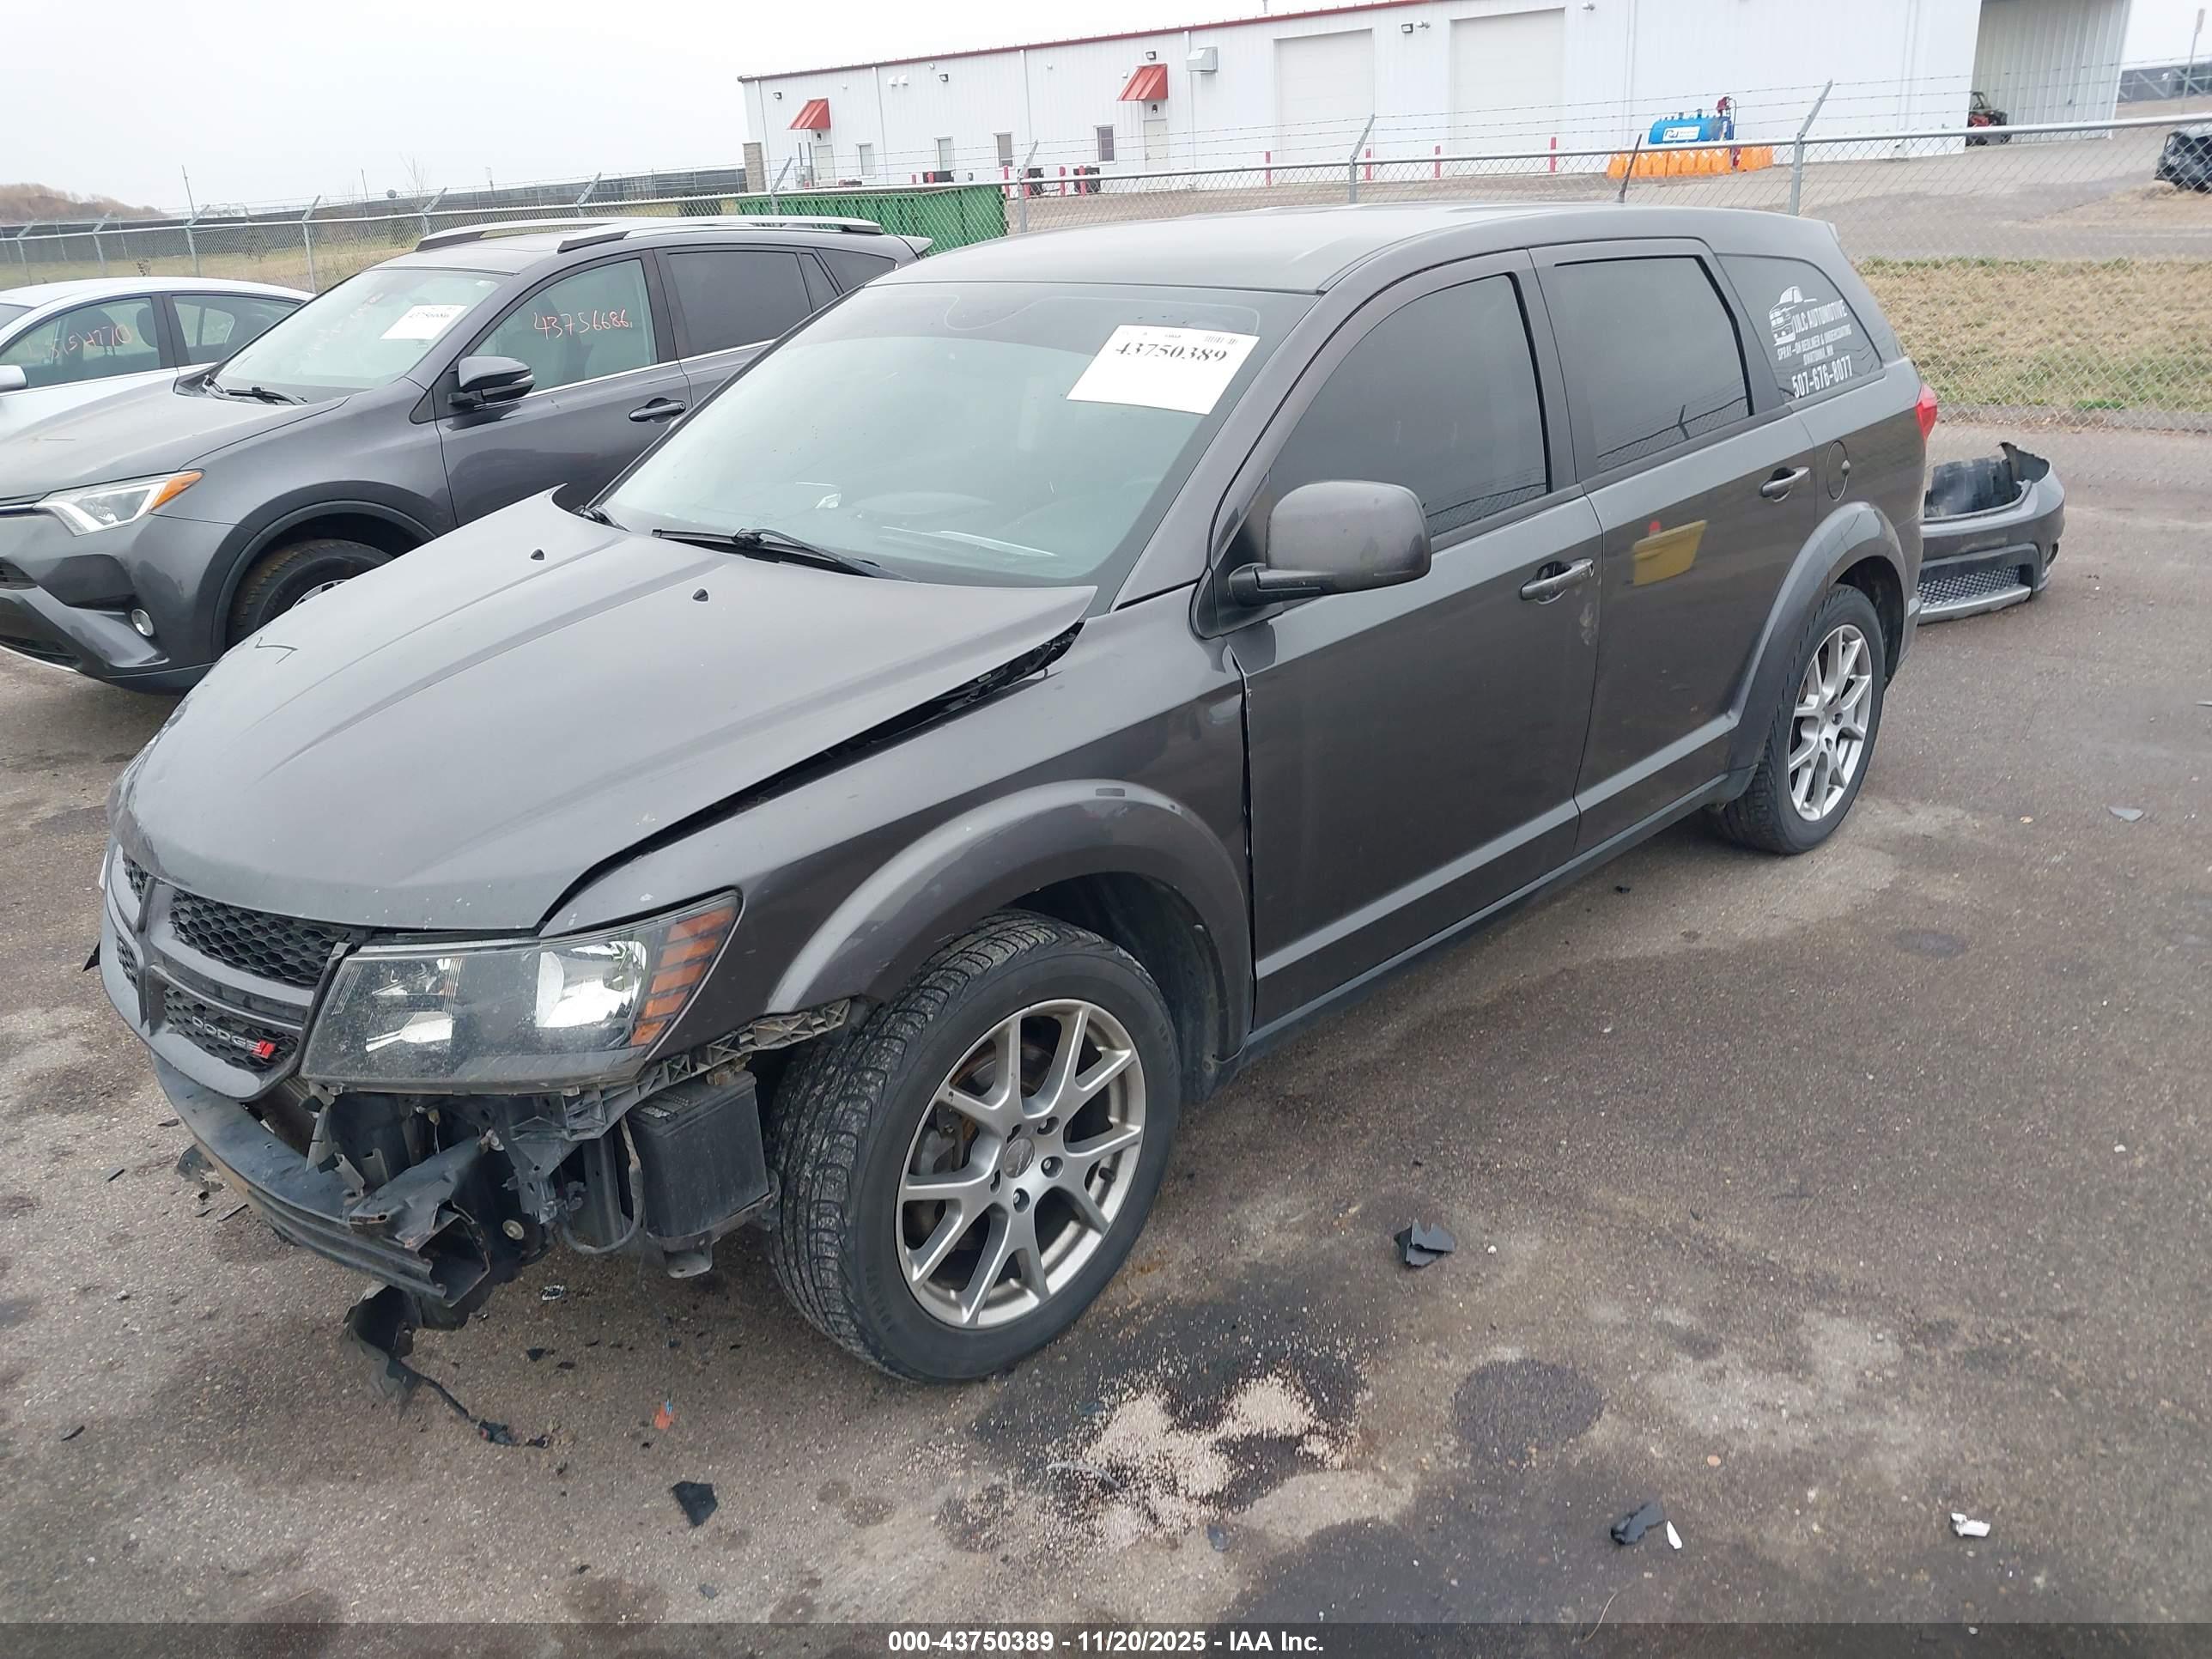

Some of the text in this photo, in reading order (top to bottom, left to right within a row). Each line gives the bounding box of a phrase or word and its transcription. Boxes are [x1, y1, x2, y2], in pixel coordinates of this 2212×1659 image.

[1115, 343, 1228, 362] 43750389
[1792, 355, 1853, 398] 507-676-8077
[191, 1015, 262, 1053] DODGE
